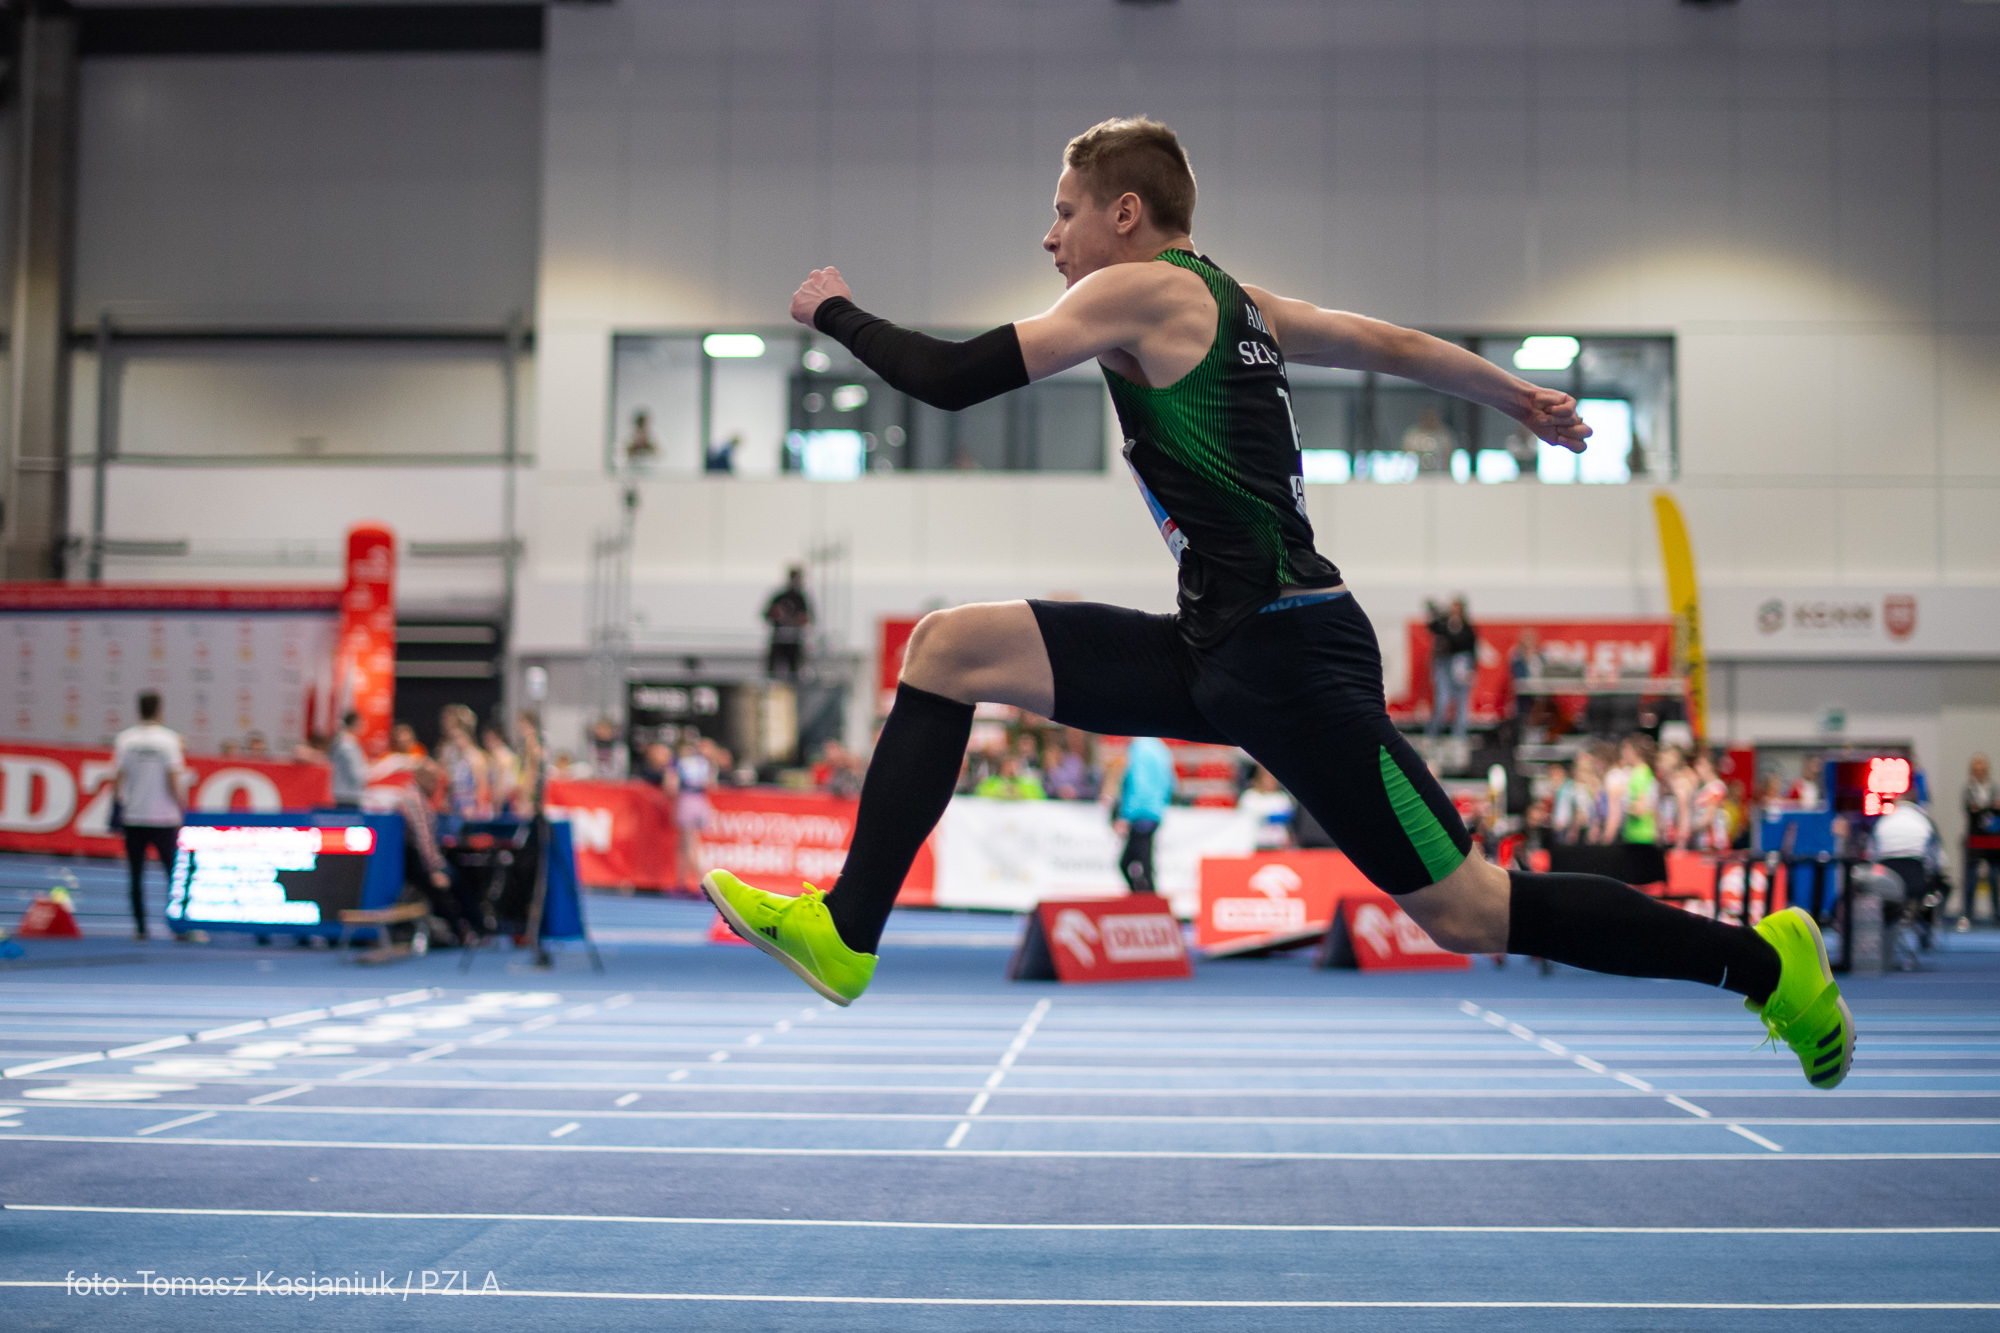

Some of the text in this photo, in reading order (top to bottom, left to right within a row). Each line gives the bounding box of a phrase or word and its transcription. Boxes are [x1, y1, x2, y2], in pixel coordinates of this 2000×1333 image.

[1245, 303, 1271, 336] AM
[1238, 341, 1286, 379] SŁU
[0, 754, 284, 838] DZO
